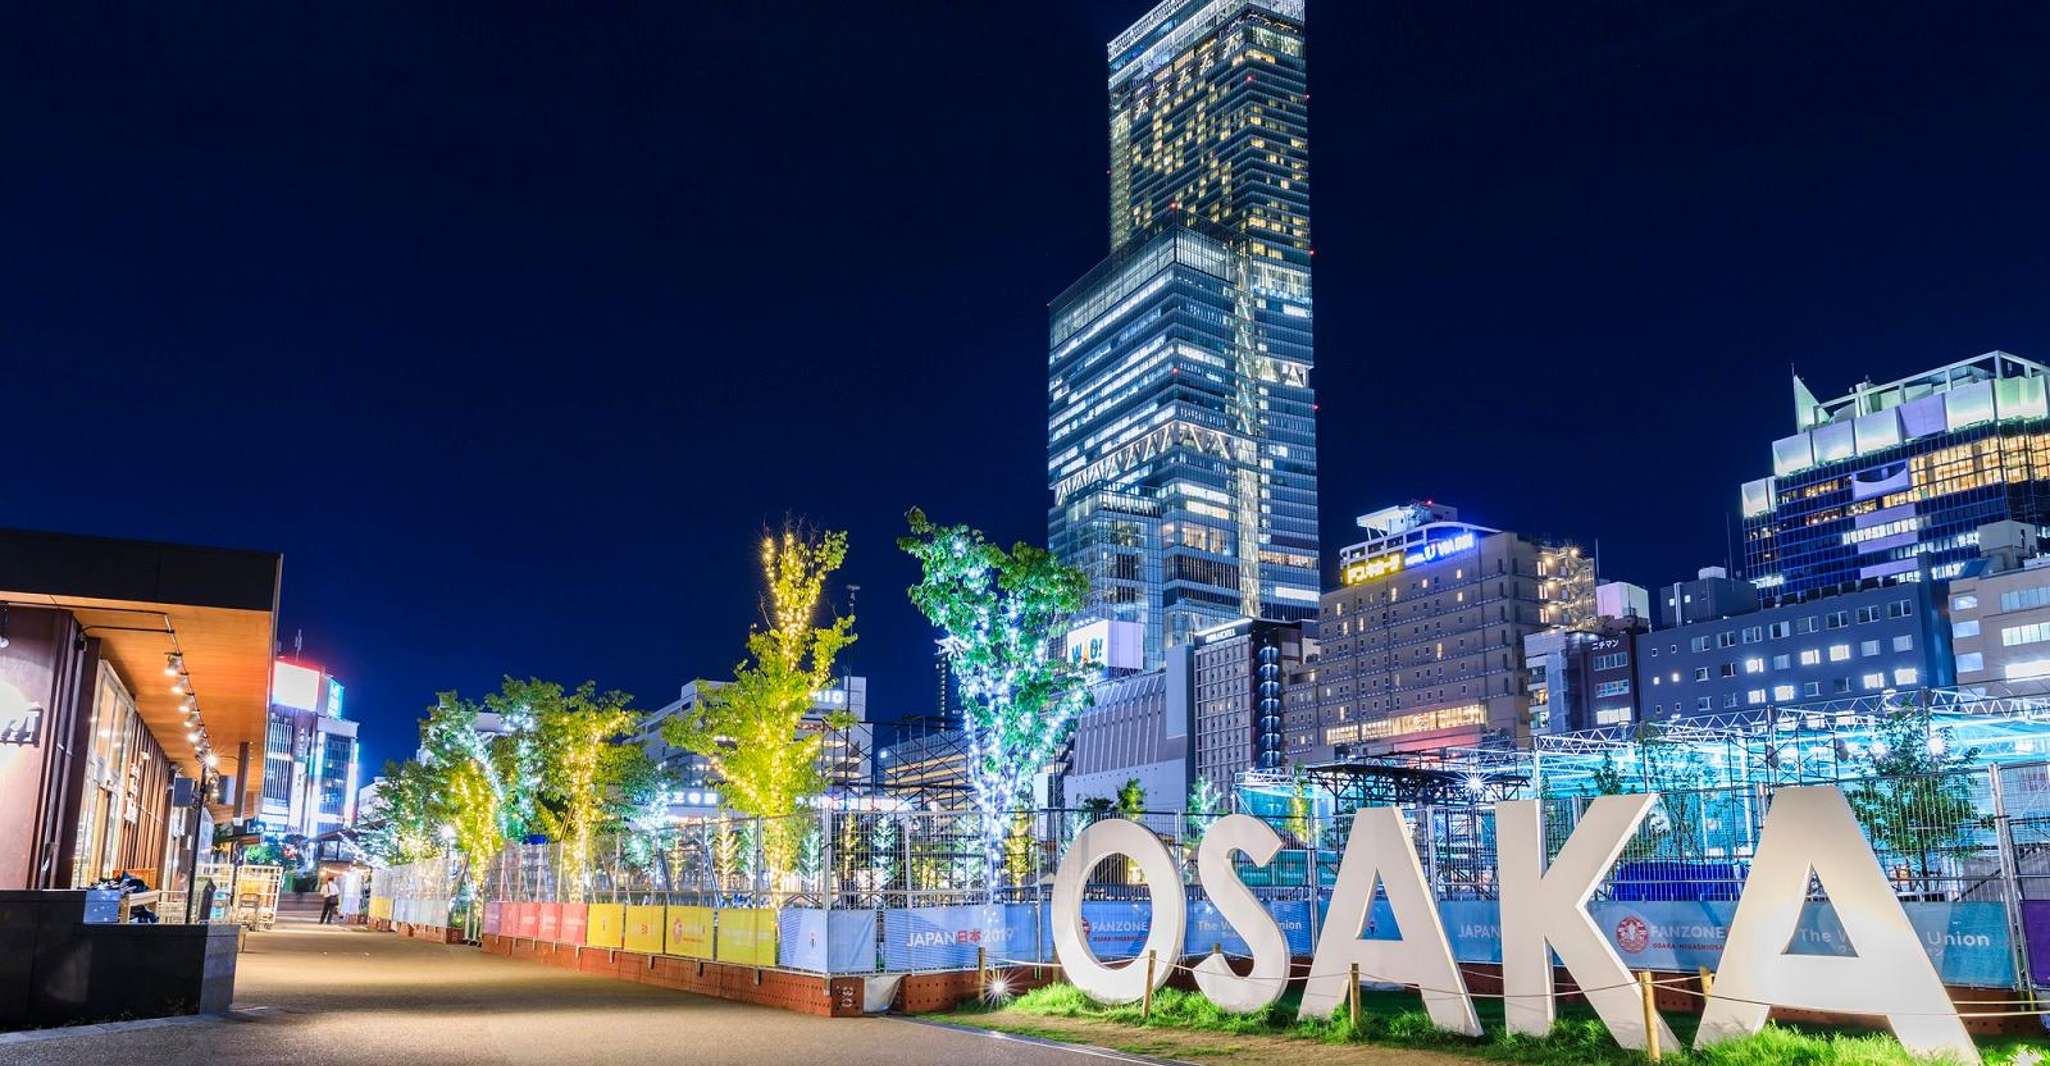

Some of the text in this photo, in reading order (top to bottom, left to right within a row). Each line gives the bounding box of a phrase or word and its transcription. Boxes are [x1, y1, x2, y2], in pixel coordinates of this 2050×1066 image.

[1592, 640, 1619, 651] ニチマン
[1051, 786, 1981, 1066] OSAKA
[1092, 920, 1149, 932] FANZONE
[1199, 921, 1219, 931] The
[1279, 920, 1303, 931] nion
[1457, 924, 1500, 939] JAPAN
[1651, 925, 1726, 939] FANZONE
[1800, 928, 1831, 943] The
[1927, 930, 1990, 946] Union
